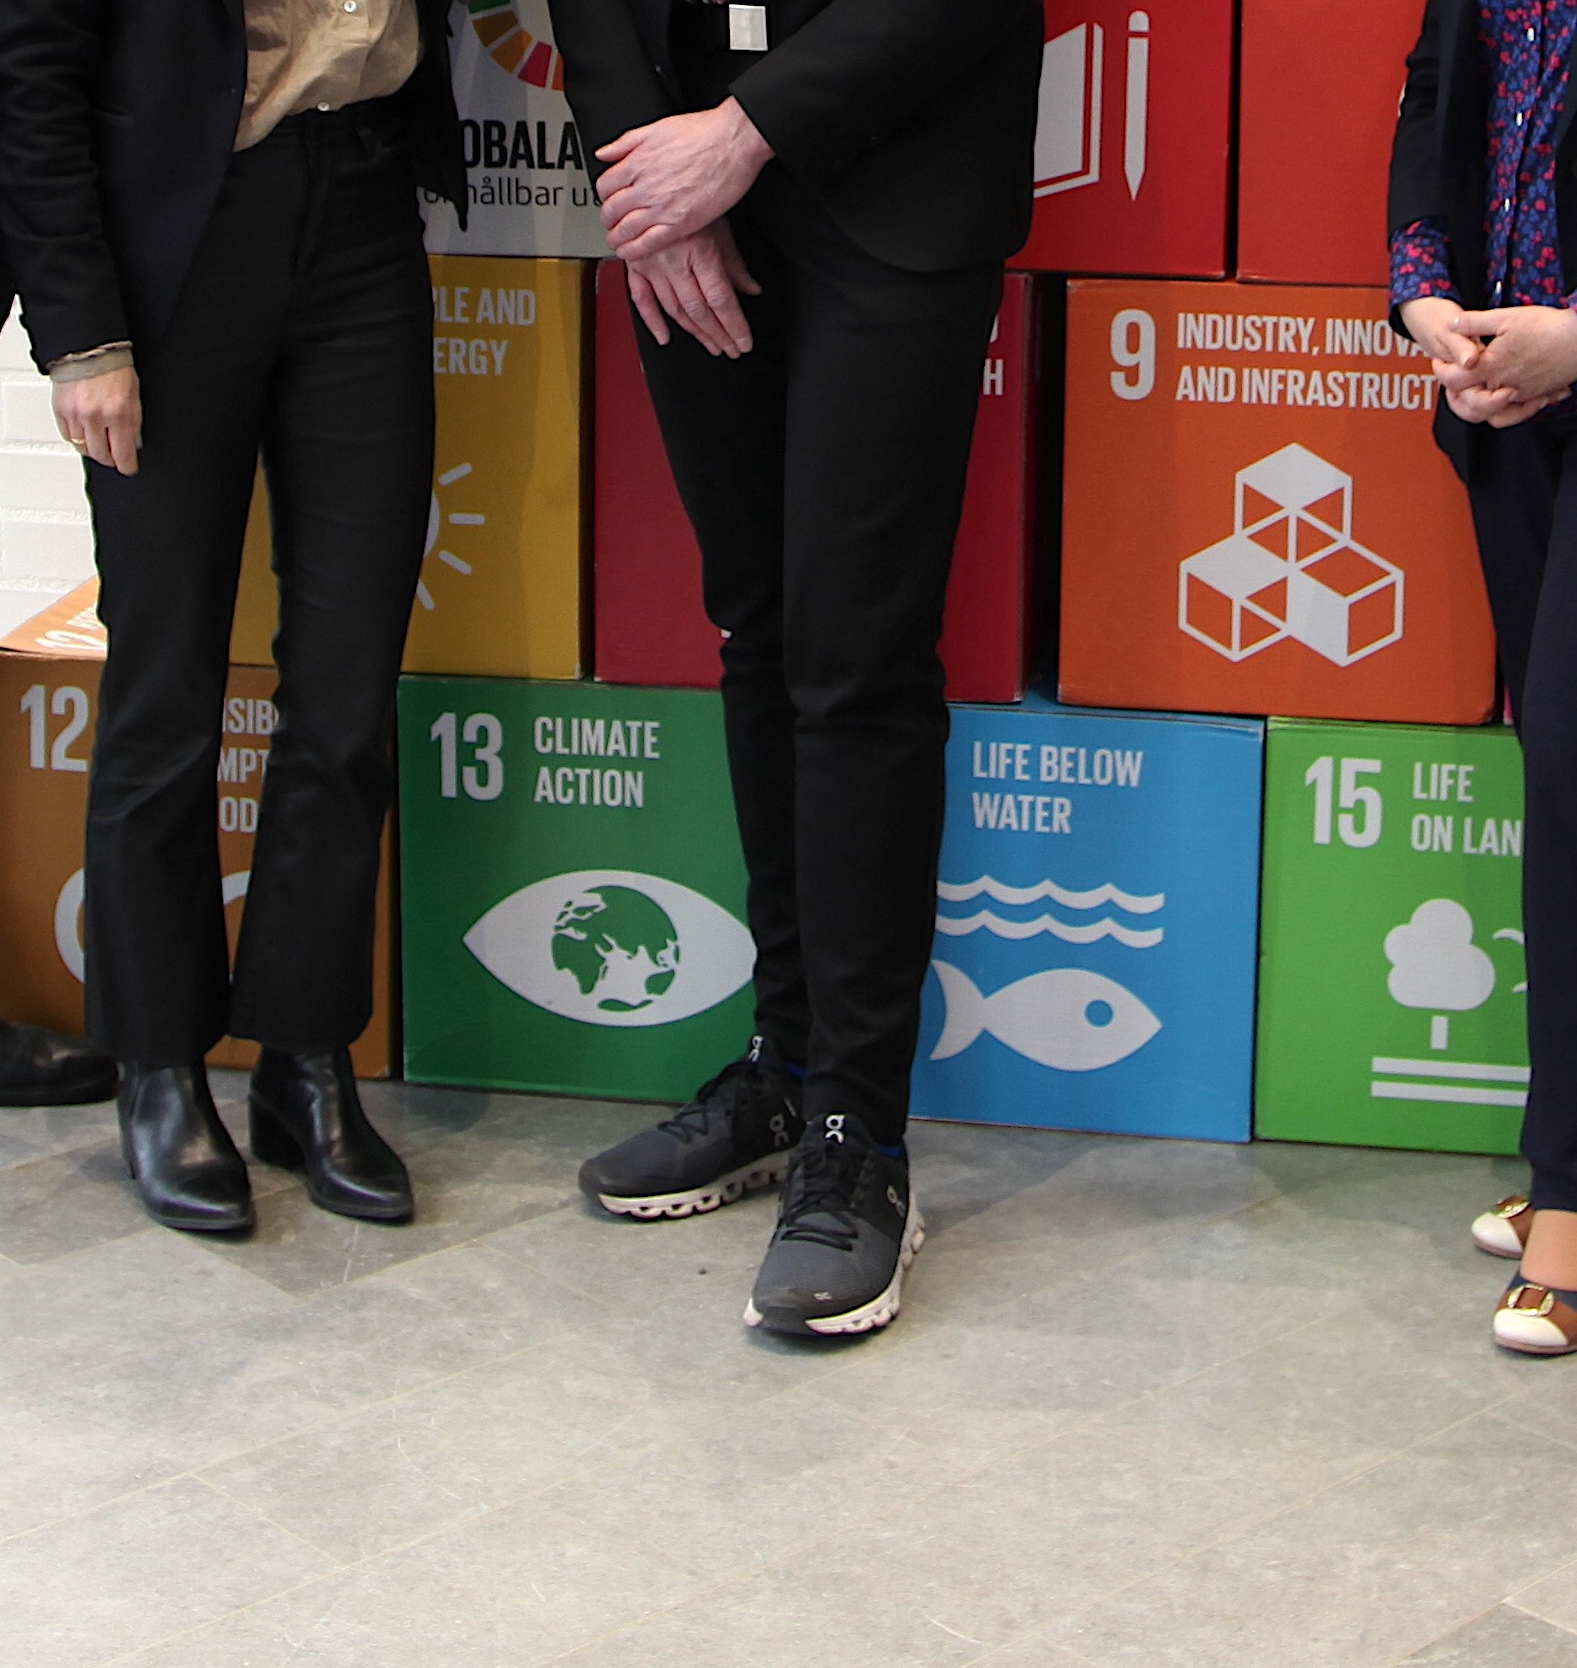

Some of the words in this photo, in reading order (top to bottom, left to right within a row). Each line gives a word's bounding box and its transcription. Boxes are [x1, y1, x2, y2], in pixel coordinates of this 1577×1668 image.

[475, 288, 536, 326] AND
[1110, 309, 1156, 401] 9
[1177, 313, 1320, 356] INDUSTRY,
[1175, 365, 1236, 403] AND
[21, 684, 89, 772] 12
[533, 716, 661, 759] CLIMATE
[430, 711, 504, 801] 13
[972, 741, 1030, 782] LIFE
[1039, 745, 1143, 787] BELOW
[534, 766, 645, 808] ACTION
[1304, 756, 1382, 848] 15
[1412, 763, 1475, 803] LIFE
[972, 792, 1072, 833] WATER
[1410, 814, 1454, 852] ON
